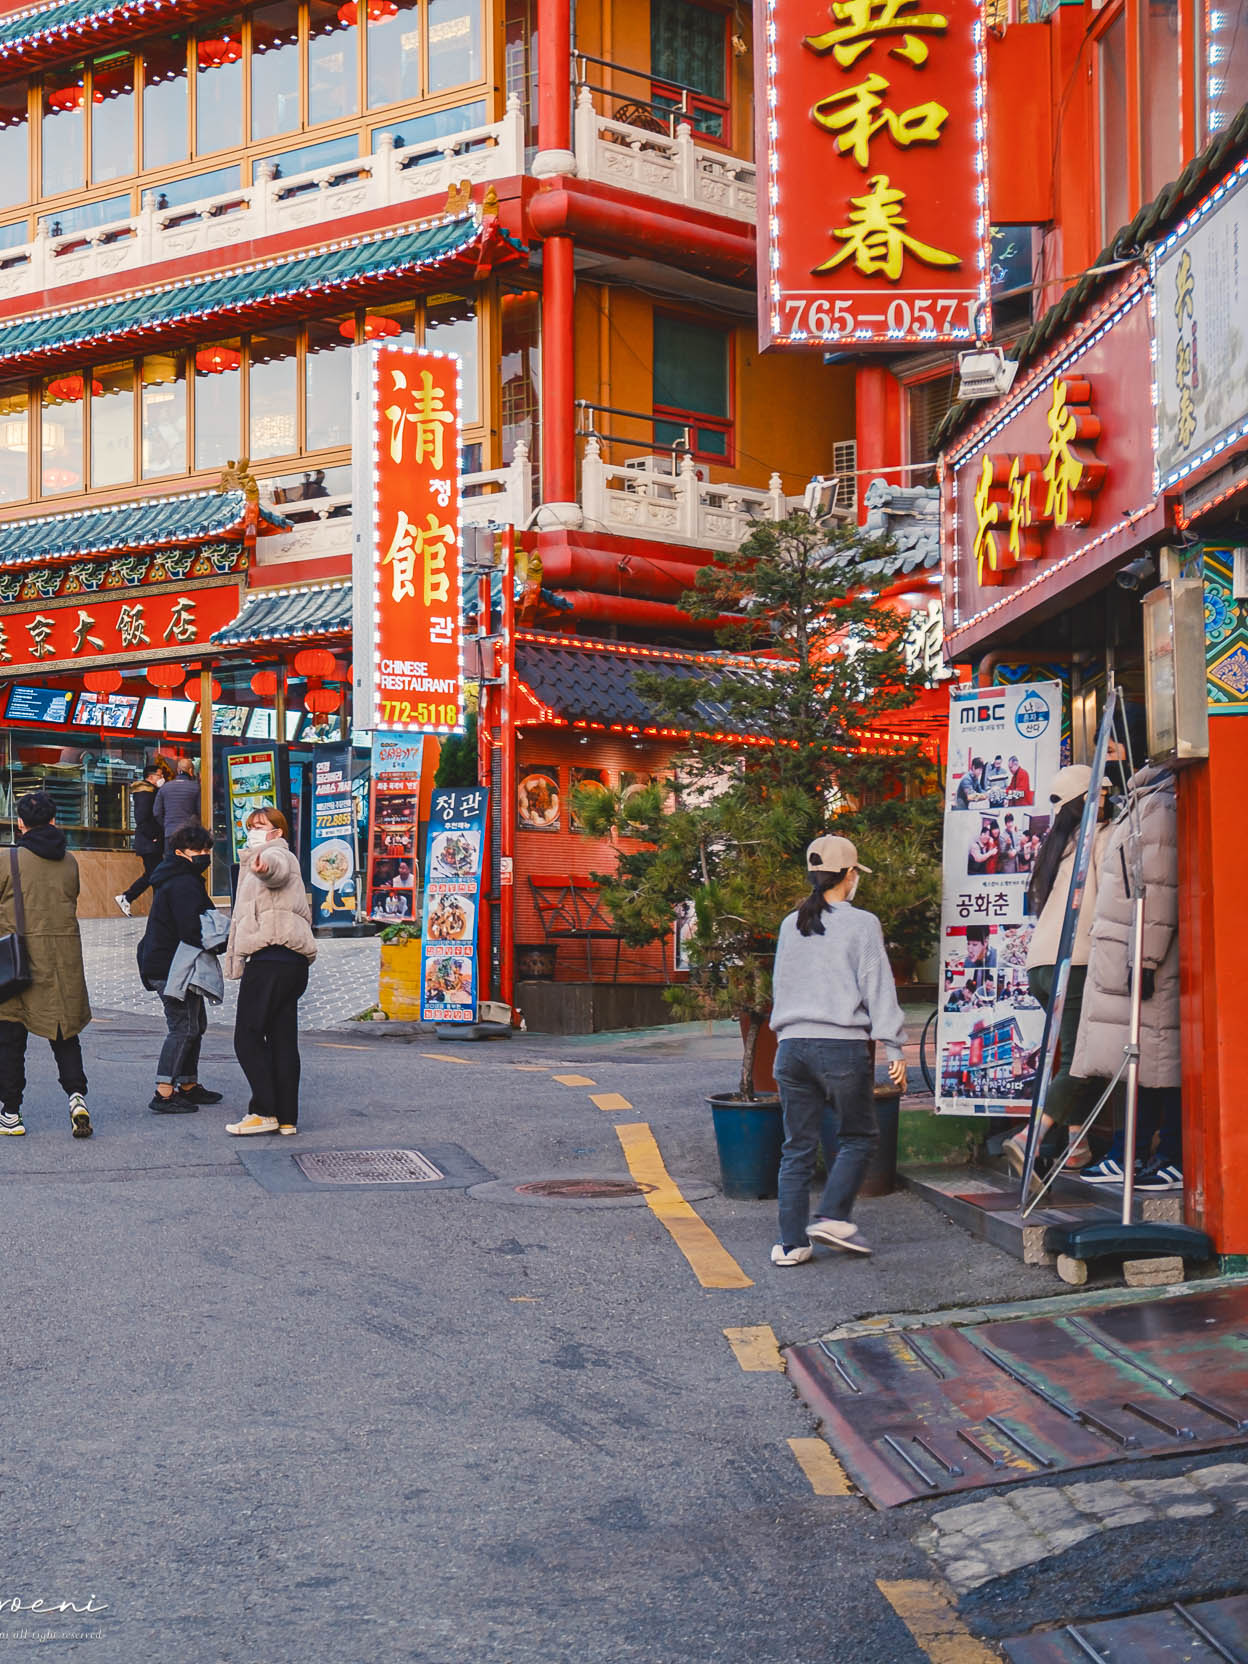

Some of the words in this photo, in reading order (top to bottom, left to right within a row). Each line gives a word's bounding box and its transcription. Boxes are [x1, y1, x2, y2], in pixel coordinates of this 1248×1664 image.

[785, 299, 980, 336] 765-0571
[381, 659, 428, 677] CHINESE
[381, 675, 456, 694] RESTAURANT
[382, 701, 456, 726] 772-5118
[435, 791, 482, 820] 청관
[956, 892, 1009, 918] 공화춘
